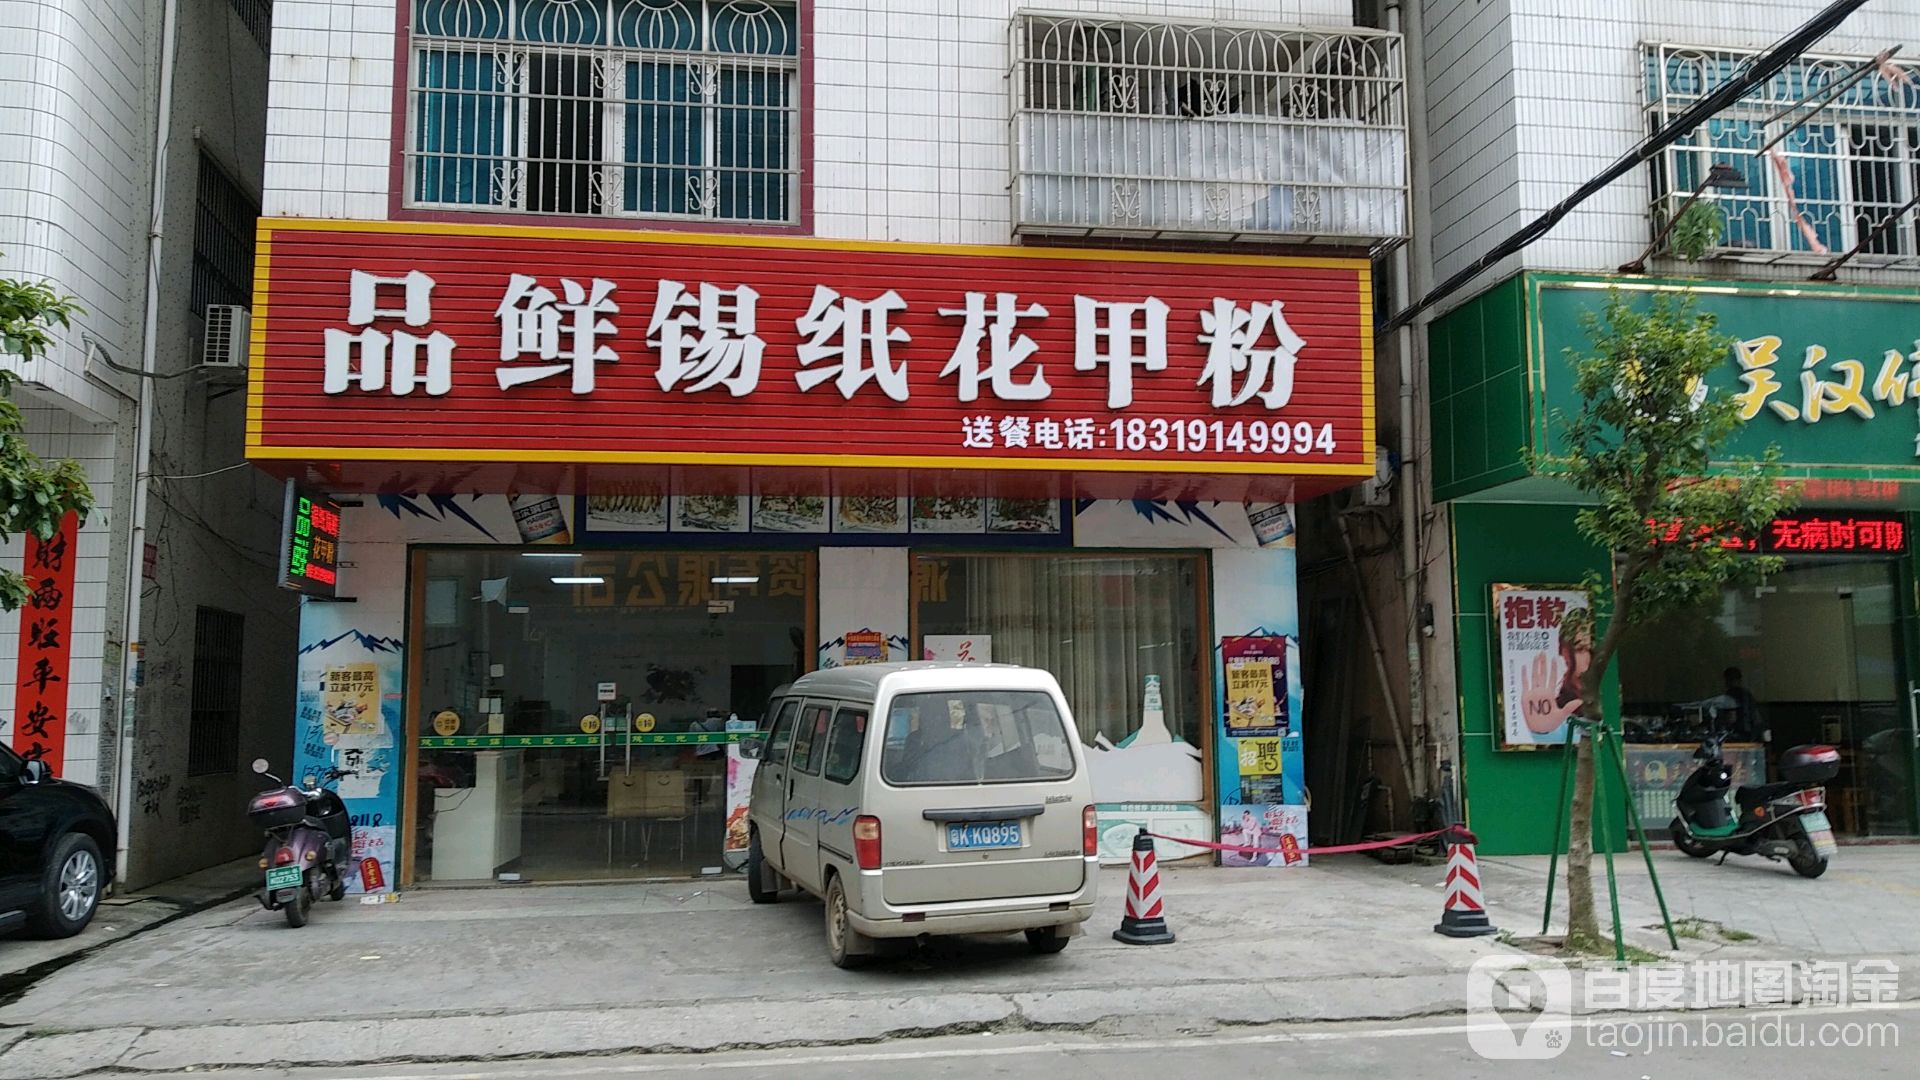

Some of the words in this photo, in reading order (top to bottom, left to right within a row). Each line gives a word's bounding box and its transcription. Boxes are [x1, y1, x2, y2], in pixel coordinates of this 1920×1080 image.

[322, 267, 1307, 410] 品鲜锡纸花甲粉
[961, 415, 1337, 455] 送餐电话:18319149994
[1504, 596, 1567, 629] 抱歉
[329, 671, 375, 682] 新客最高
[329, 682, 375, 693] 立减17元
[1529, 699, 1552, 716] NO
